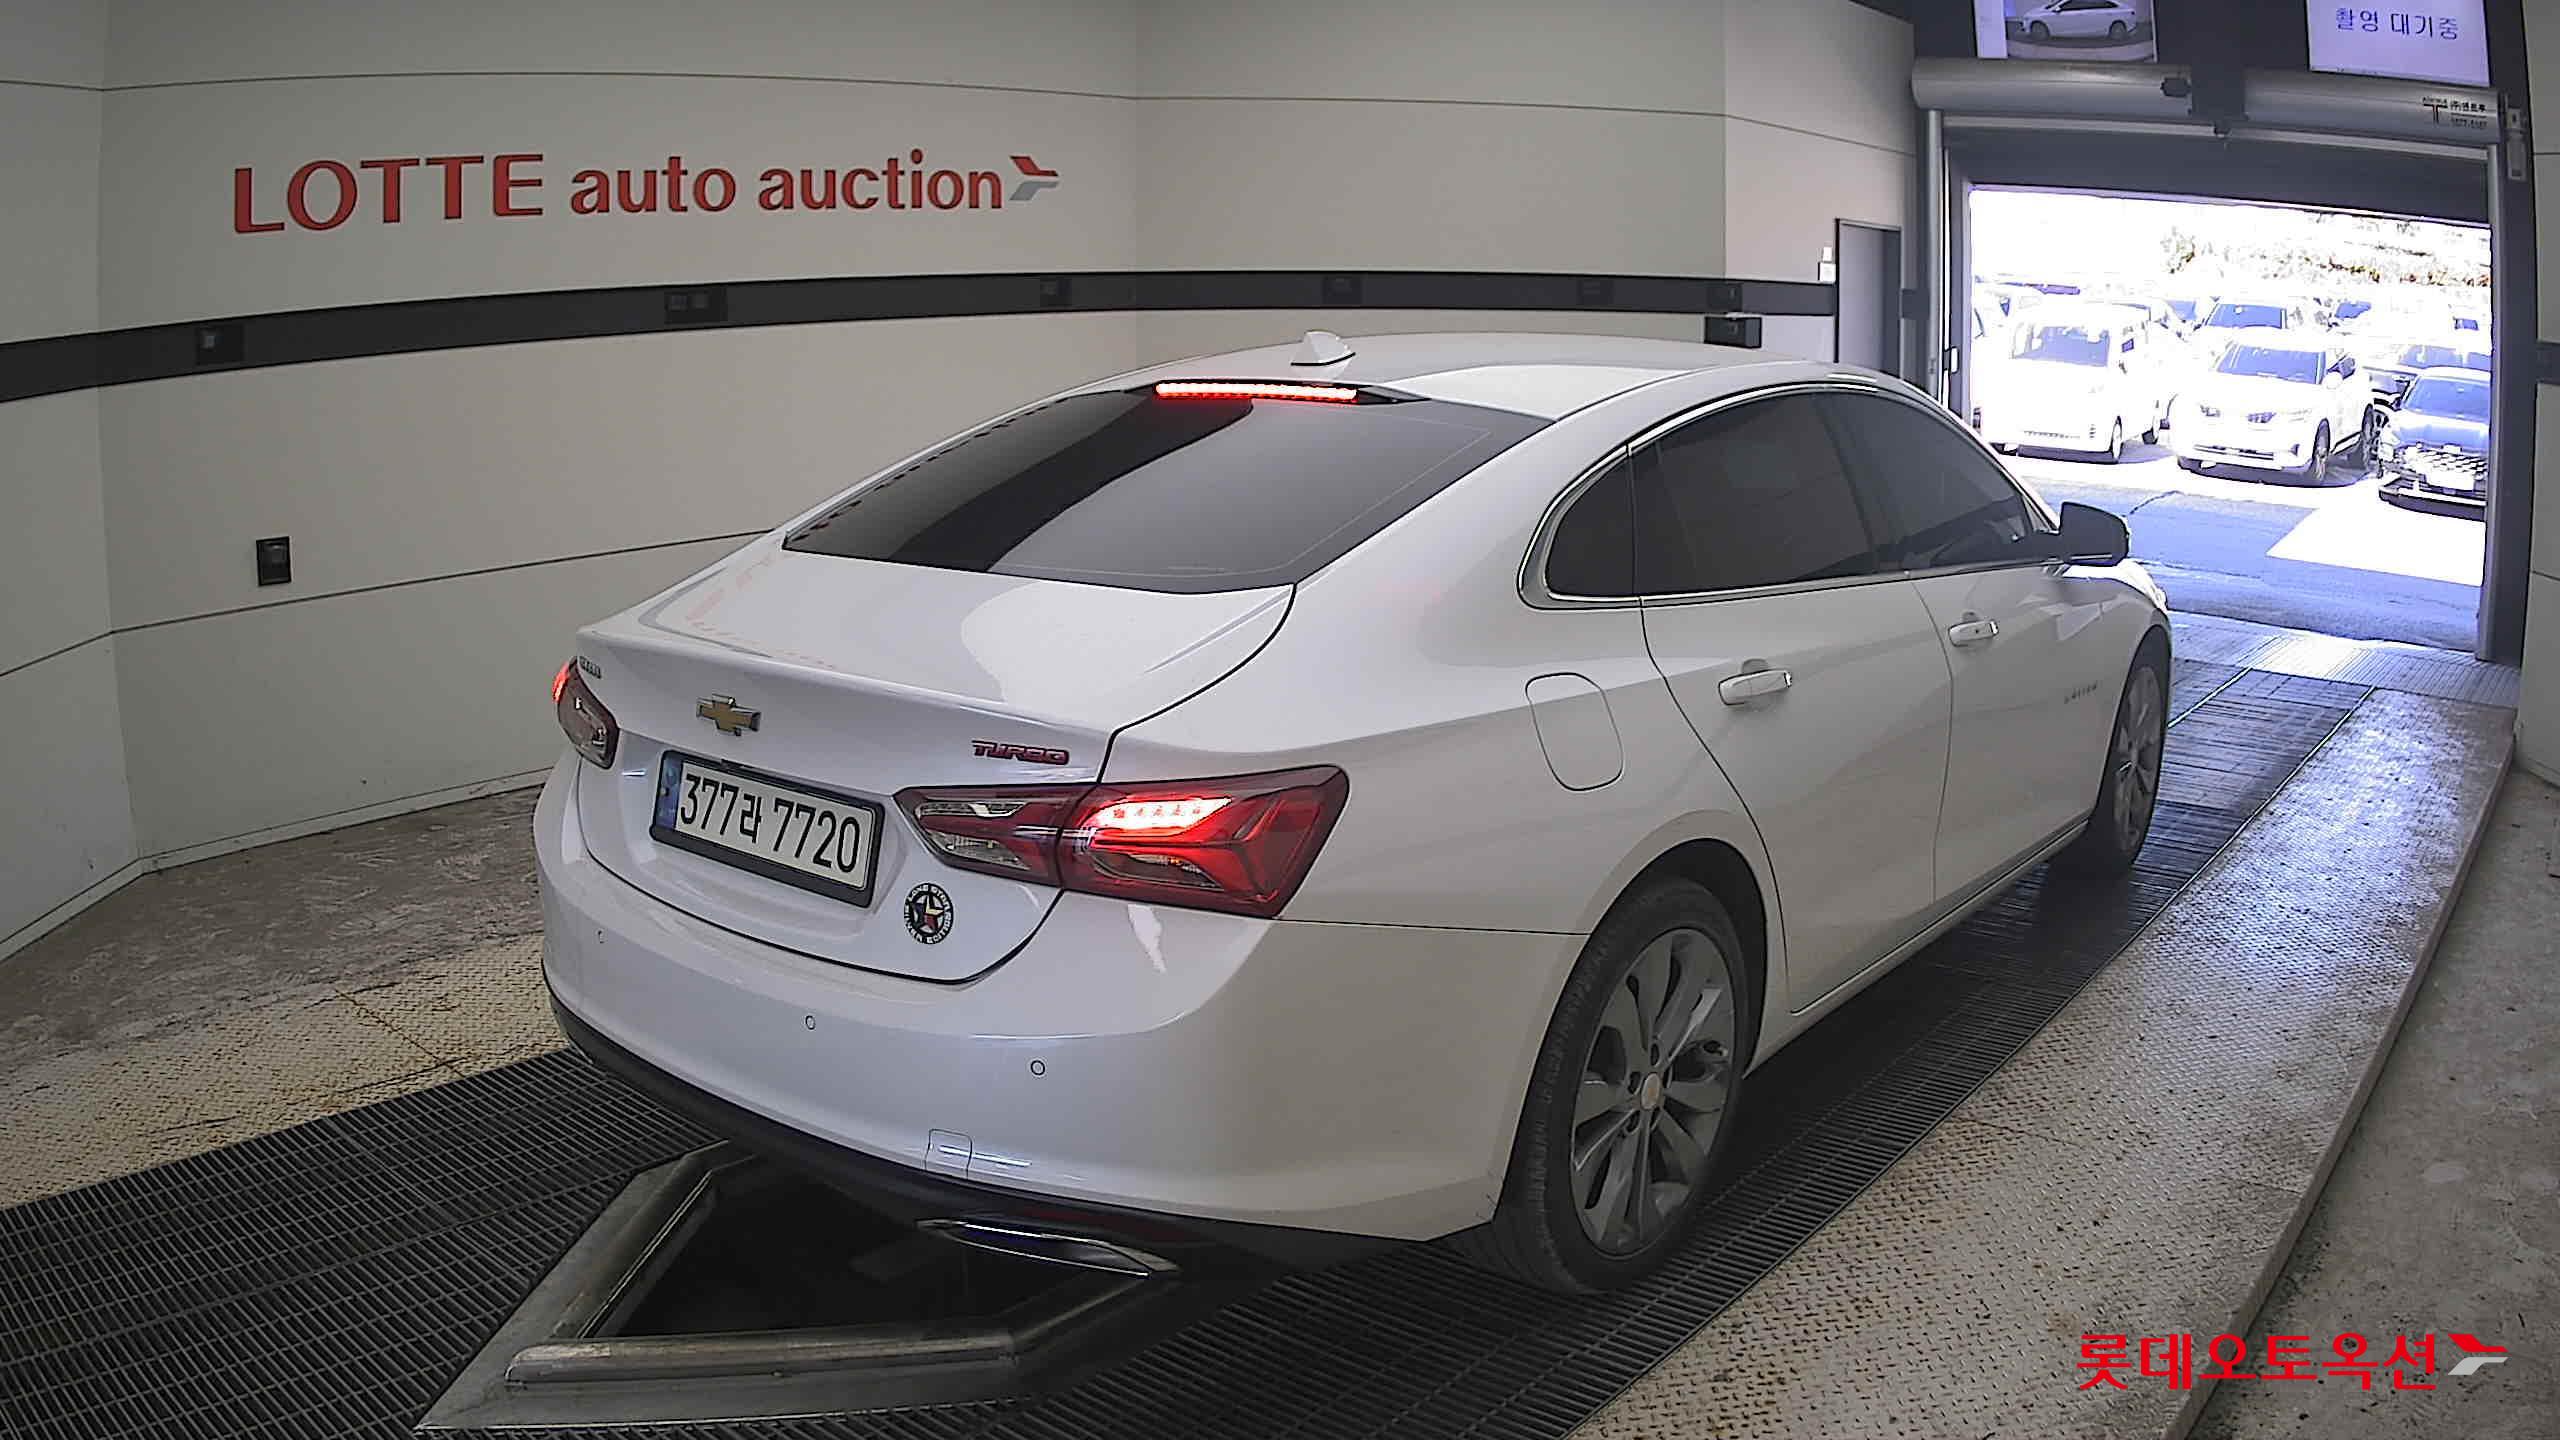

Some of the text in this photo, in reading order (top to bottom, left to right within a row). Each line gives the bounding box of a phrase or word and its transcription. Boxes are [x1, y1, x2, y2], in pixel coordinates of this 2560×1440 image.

[2335, 8, 2458, 40] 촬영 대기중
[234, 148, 1004, 233] LOTTE auto auction
[971, 740, 1070, 766] TURBO
[680, 773, 860, 873] 377라 7720
